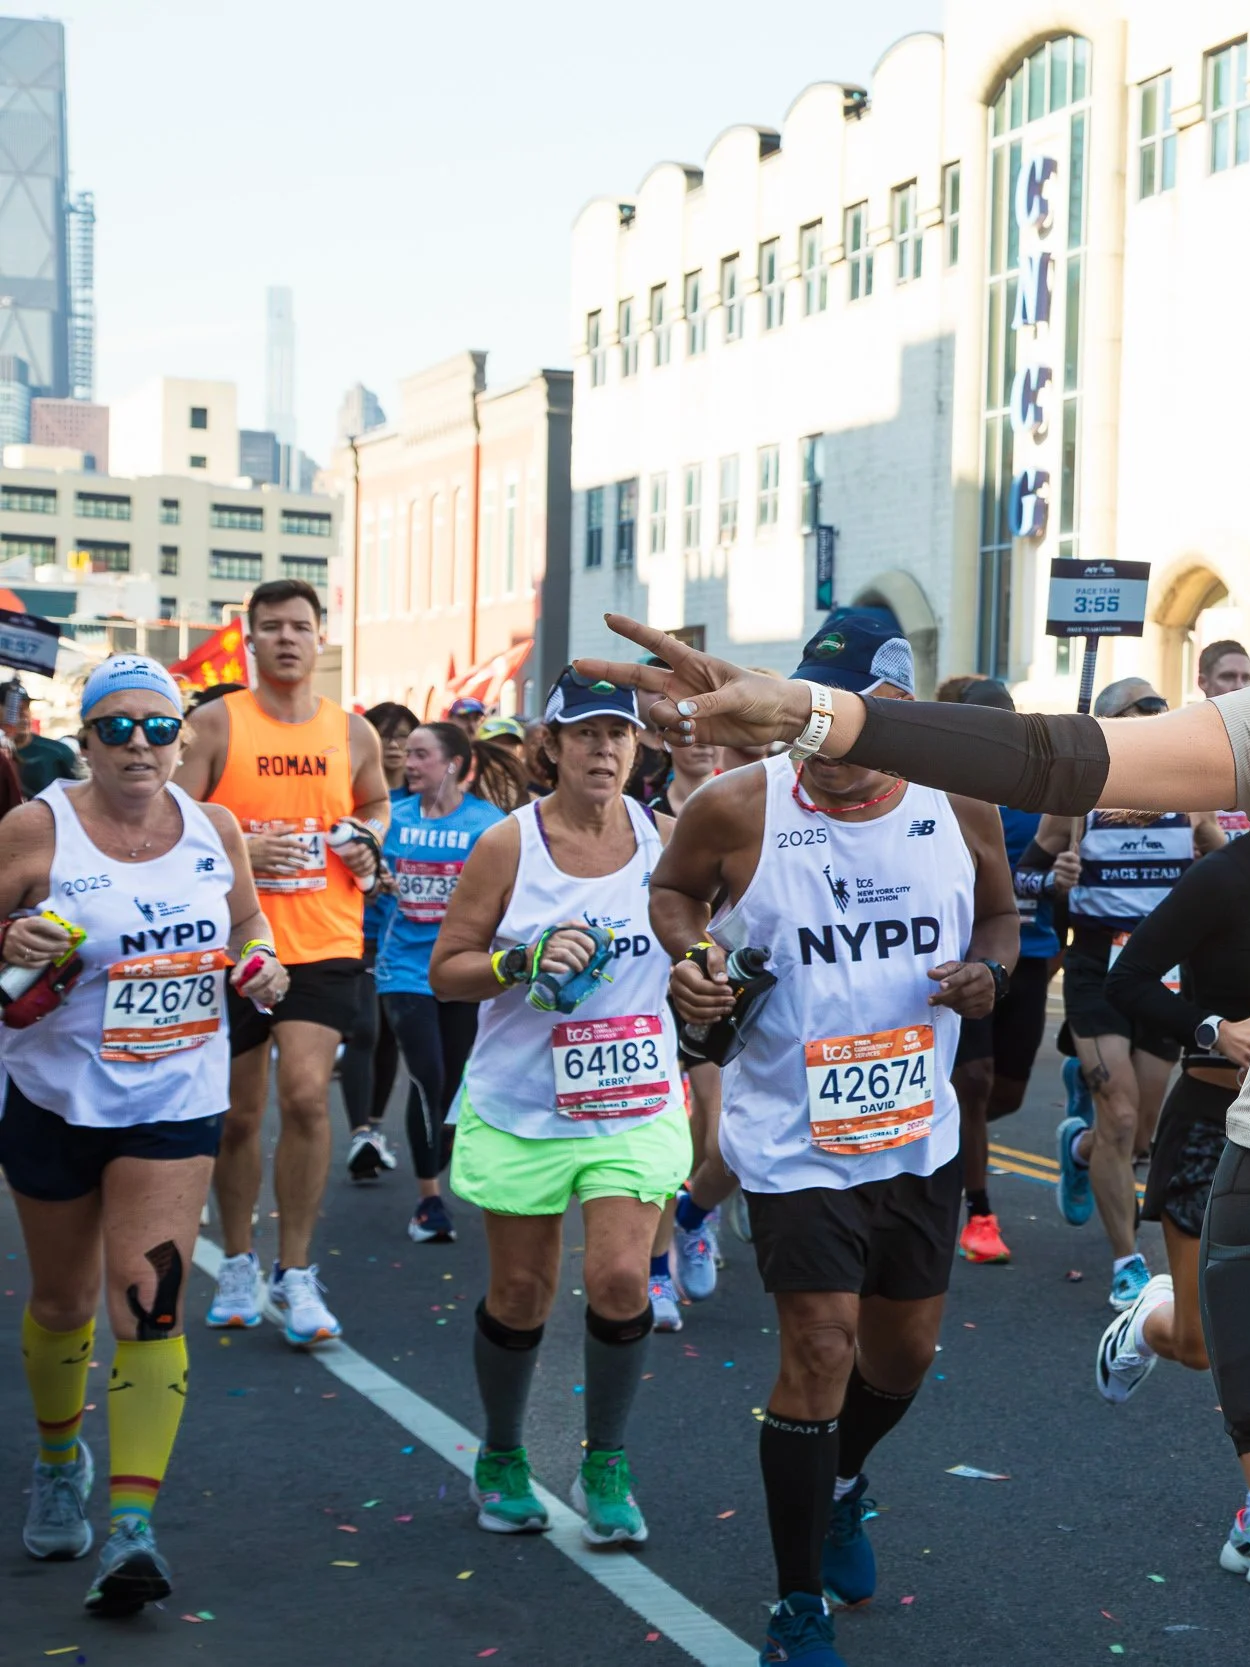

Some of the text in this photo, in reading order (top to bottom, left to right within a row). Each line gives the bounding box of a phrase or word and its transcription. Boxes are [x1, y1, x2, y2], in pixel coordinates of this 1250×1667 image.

[1073, 596, 1120, 613] 3:55
[257, 755, 327, 777] ROMAN
[776, 828, 828, 849] 2025
[856, 877, 874, 889] tcs
[1101, 866, 1182, 880] PACE TEAM
[61, 874, 113, 897] 2025
[875, 887, 895, 896] YORK
[895, 885, 911, 894] CITY
[857, 894, 899, 904] MARATHON
[121, 920, 216, 956] NYPD
[613, 934, 651, 959] PD
[797, 916, 940, 966] NYPD
[113, 974, 215, 1015] 42678
[566, 1026, 593, 1043] tcs
[564, 1039, 659, 1080] 64183
[822, 1043, 852, 1062] tcs
[598, 1075, 632, 1088] KERRY
[819, 1055, 927, 1105] 42674
[860, 1100, 896, 1114] DAVID
